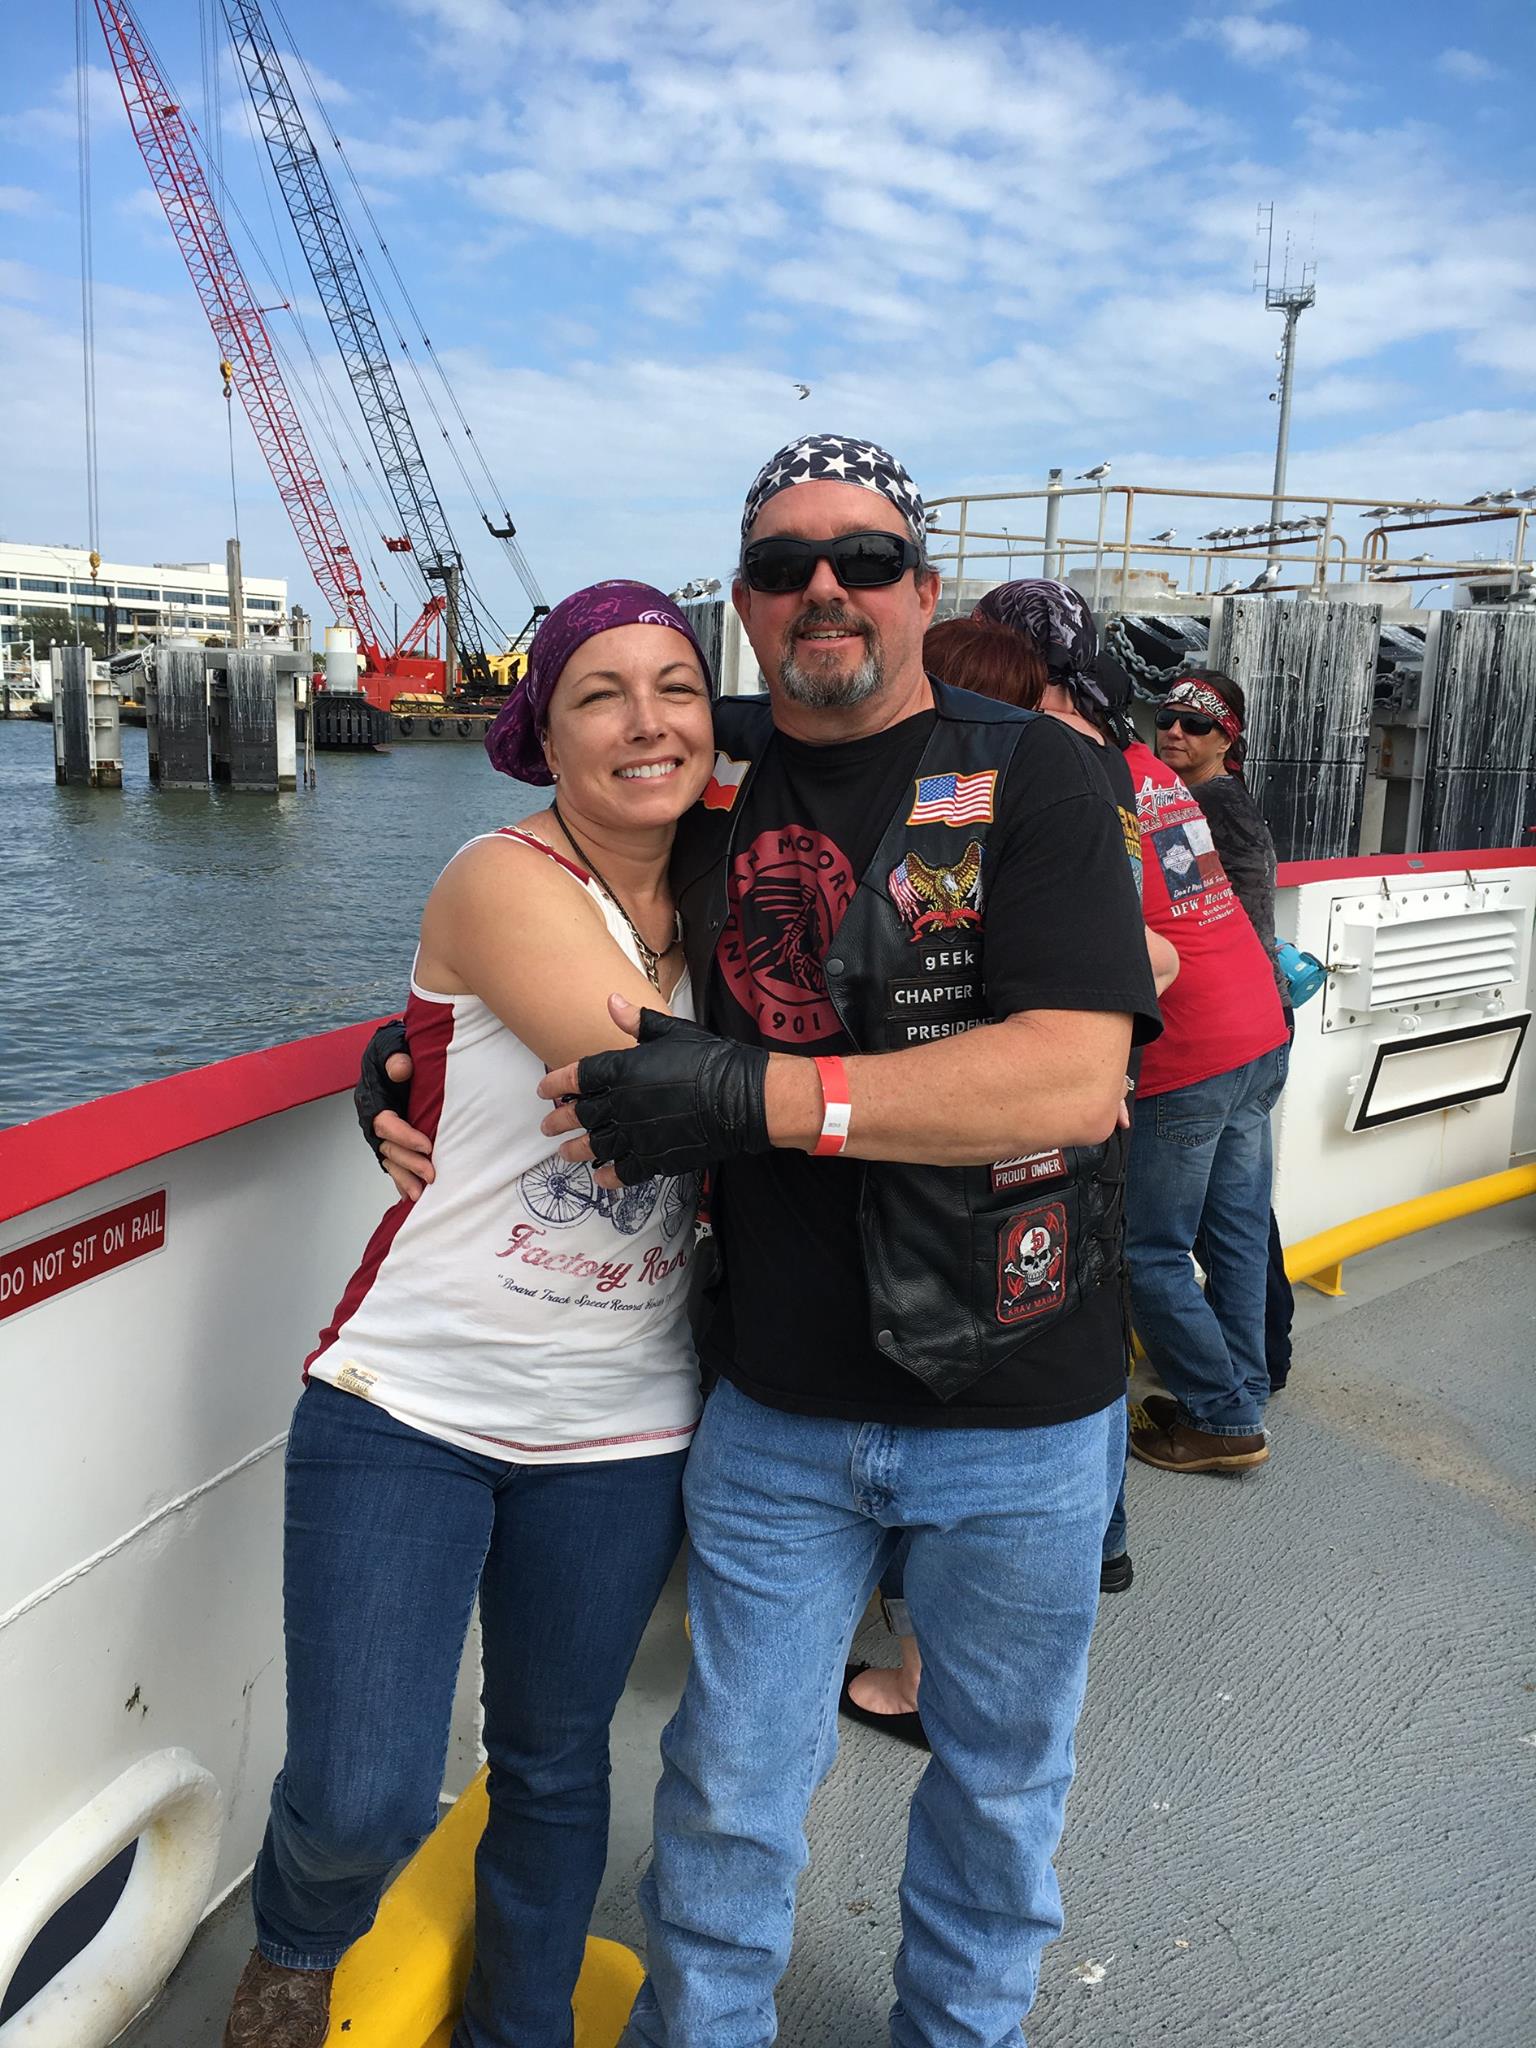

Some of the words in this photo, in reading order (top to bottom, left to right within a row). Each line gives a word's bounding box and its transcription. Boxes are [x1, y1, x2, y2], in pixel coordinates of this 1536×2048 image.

[1170, 898, 1200, 918] DFW
[925, 950, 975, 970] gEEk
[894, 985, 973, 1004] CHAPTER
[757, 1003, 821, 1035] 1901
[995, 1167, 1026, 1187] PROUD
[1031, 1158, 1061, 1178] OWNER
[0, 1266, 25, 1301] DO
[32, 1248, 65, 1287] NOT
[71, 1235, 97, 1269] SIT
[103, 1223, 125, 1255] ON
[131, 1209, 163, 1243] RAIL
[495, 1223, 633, 1293] Factory
[539, 1288, 571, 1304] Track
[574, 1294, 609, 1310] Speed
[609, 1298, 643, 1312] Record
